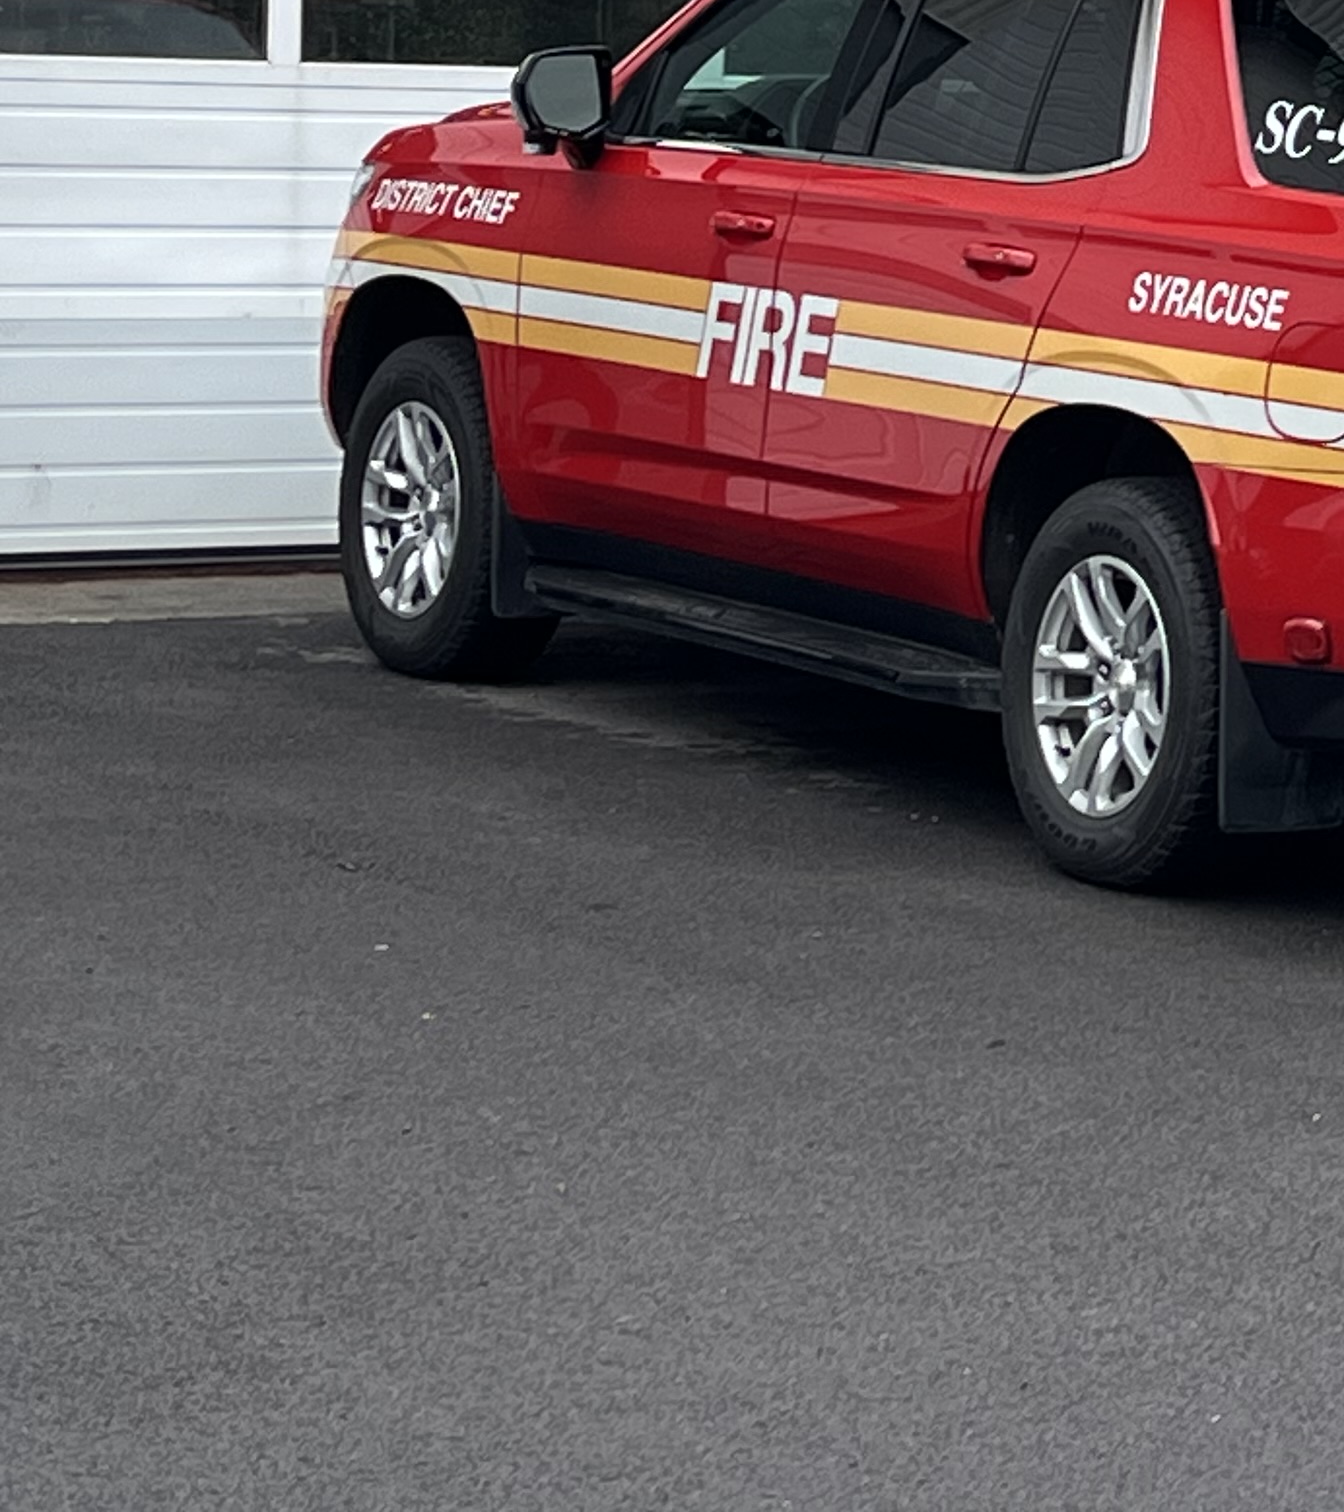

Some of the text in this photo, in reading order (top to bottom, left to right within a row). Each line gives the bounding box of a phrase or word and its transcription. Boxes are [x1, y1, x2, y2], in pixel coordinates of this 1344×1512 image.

[371, 178, 520, 224] DISTRICT CHIEF
[1128, 271, 1290, 331] SYRACUSE
[696, 281, 839, 397] FIRE
